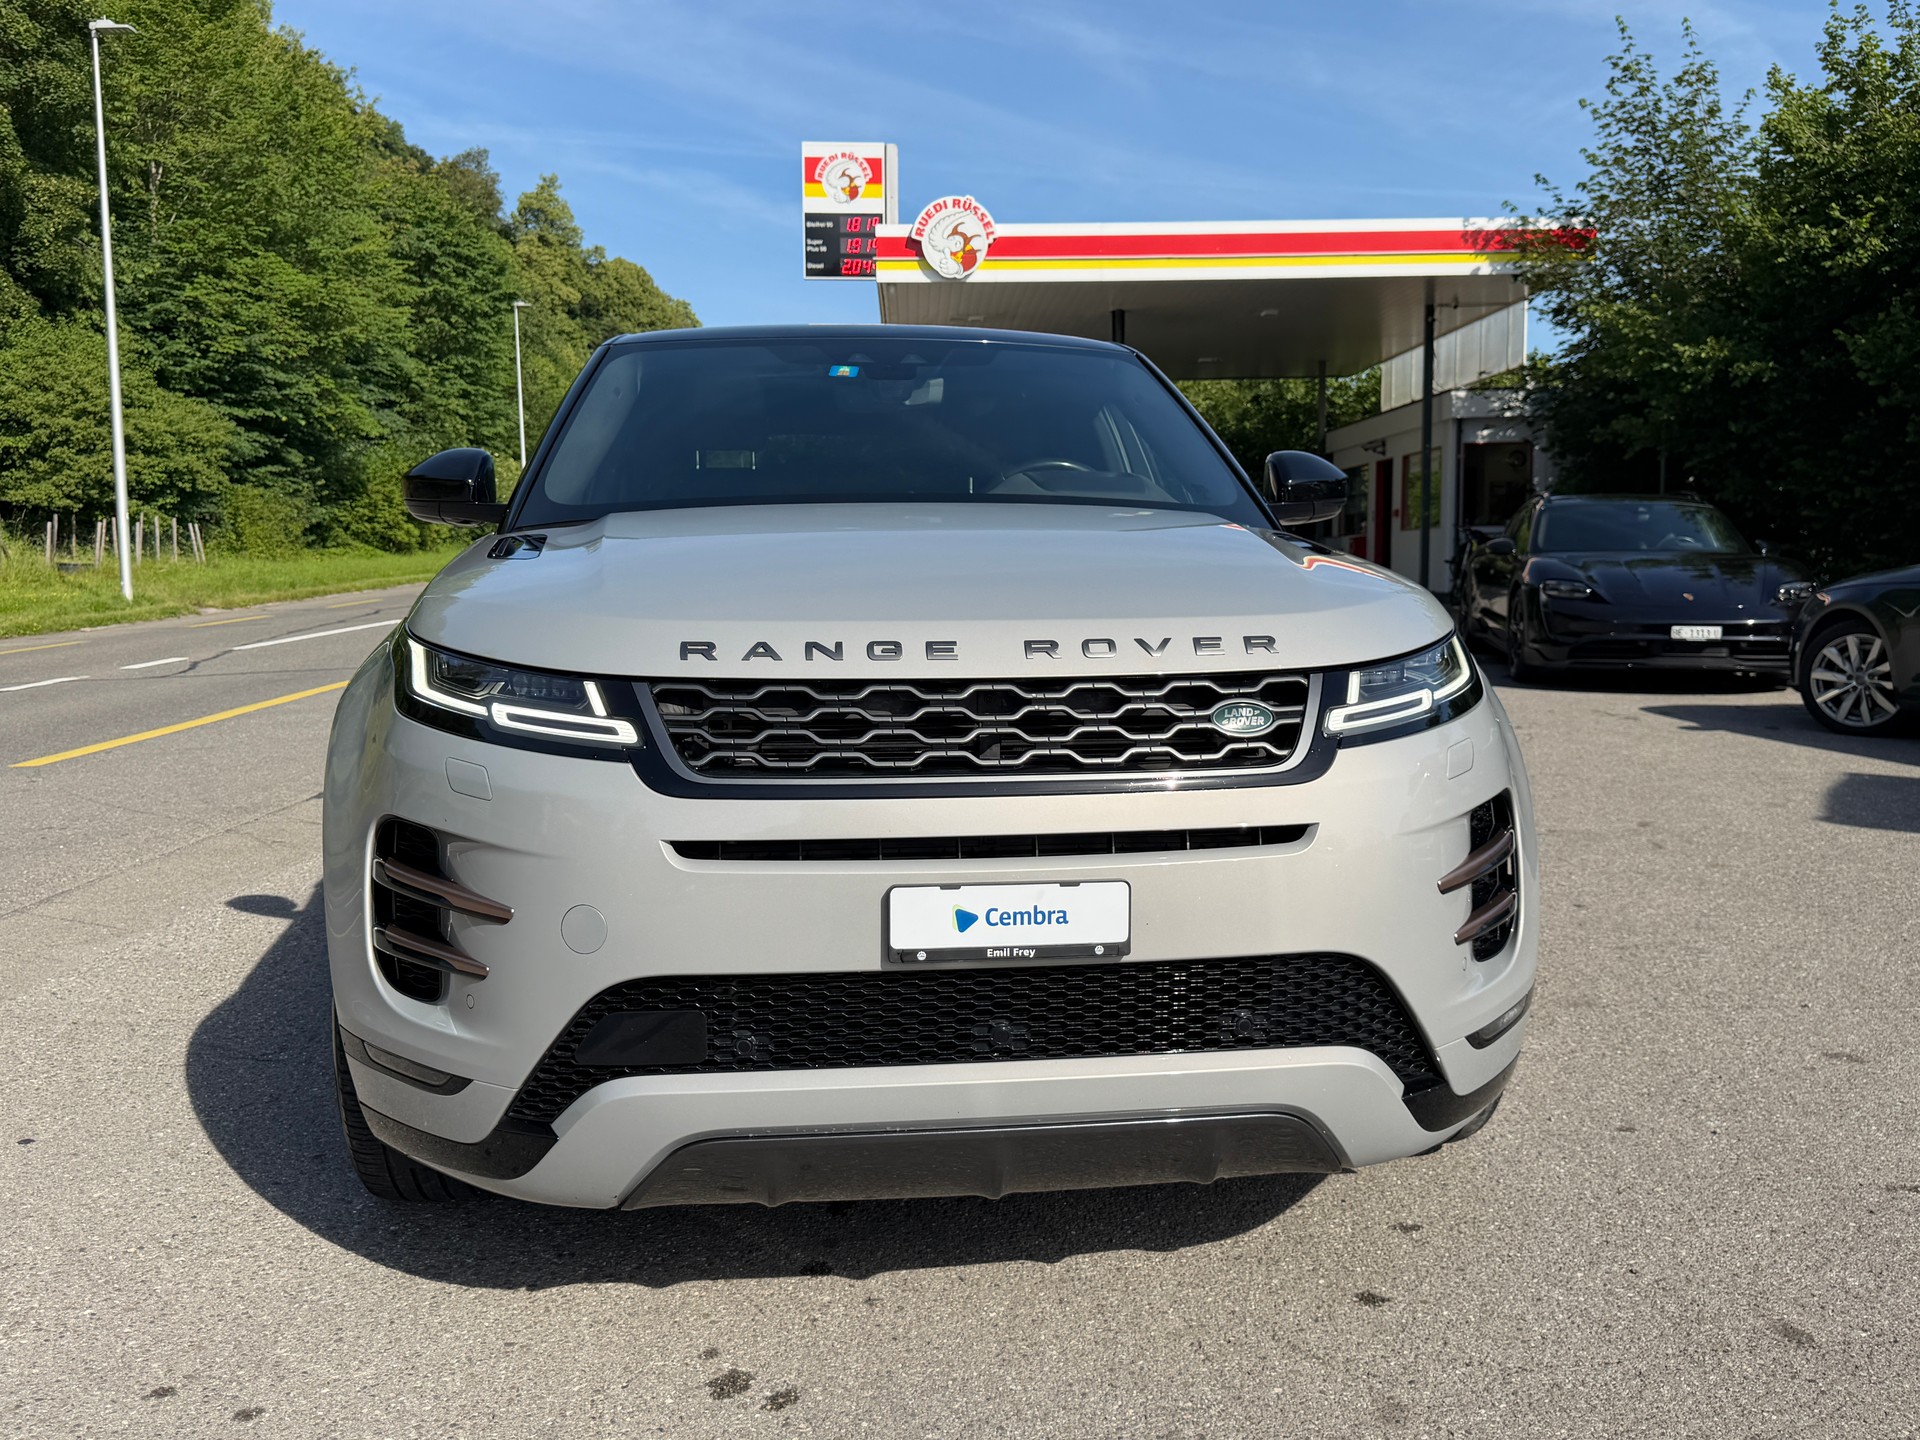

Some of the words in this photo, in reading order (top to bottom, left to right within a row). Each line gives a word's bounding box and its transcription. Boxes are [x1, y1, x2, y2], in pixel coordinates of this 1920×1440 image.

[817, 153, 838, 179] RUEDI
[841, 151, 870, 180] RÜSSEL
[915, 200, 948, 238] RUEDI
[952, 198, 995, 240] RÜSSEL
[679, 640, 959, 662] RANGE
[1023, 635, 1280, 660] ROVER
[1224, 707, 1254, 718] LAND
[1229, 716, 1265, 726] ROVER
[985, 904, 1069, 927] Cembra
[986, 948, 1010, 958] Emil
[1013, 948, 1036, 958] Frey
